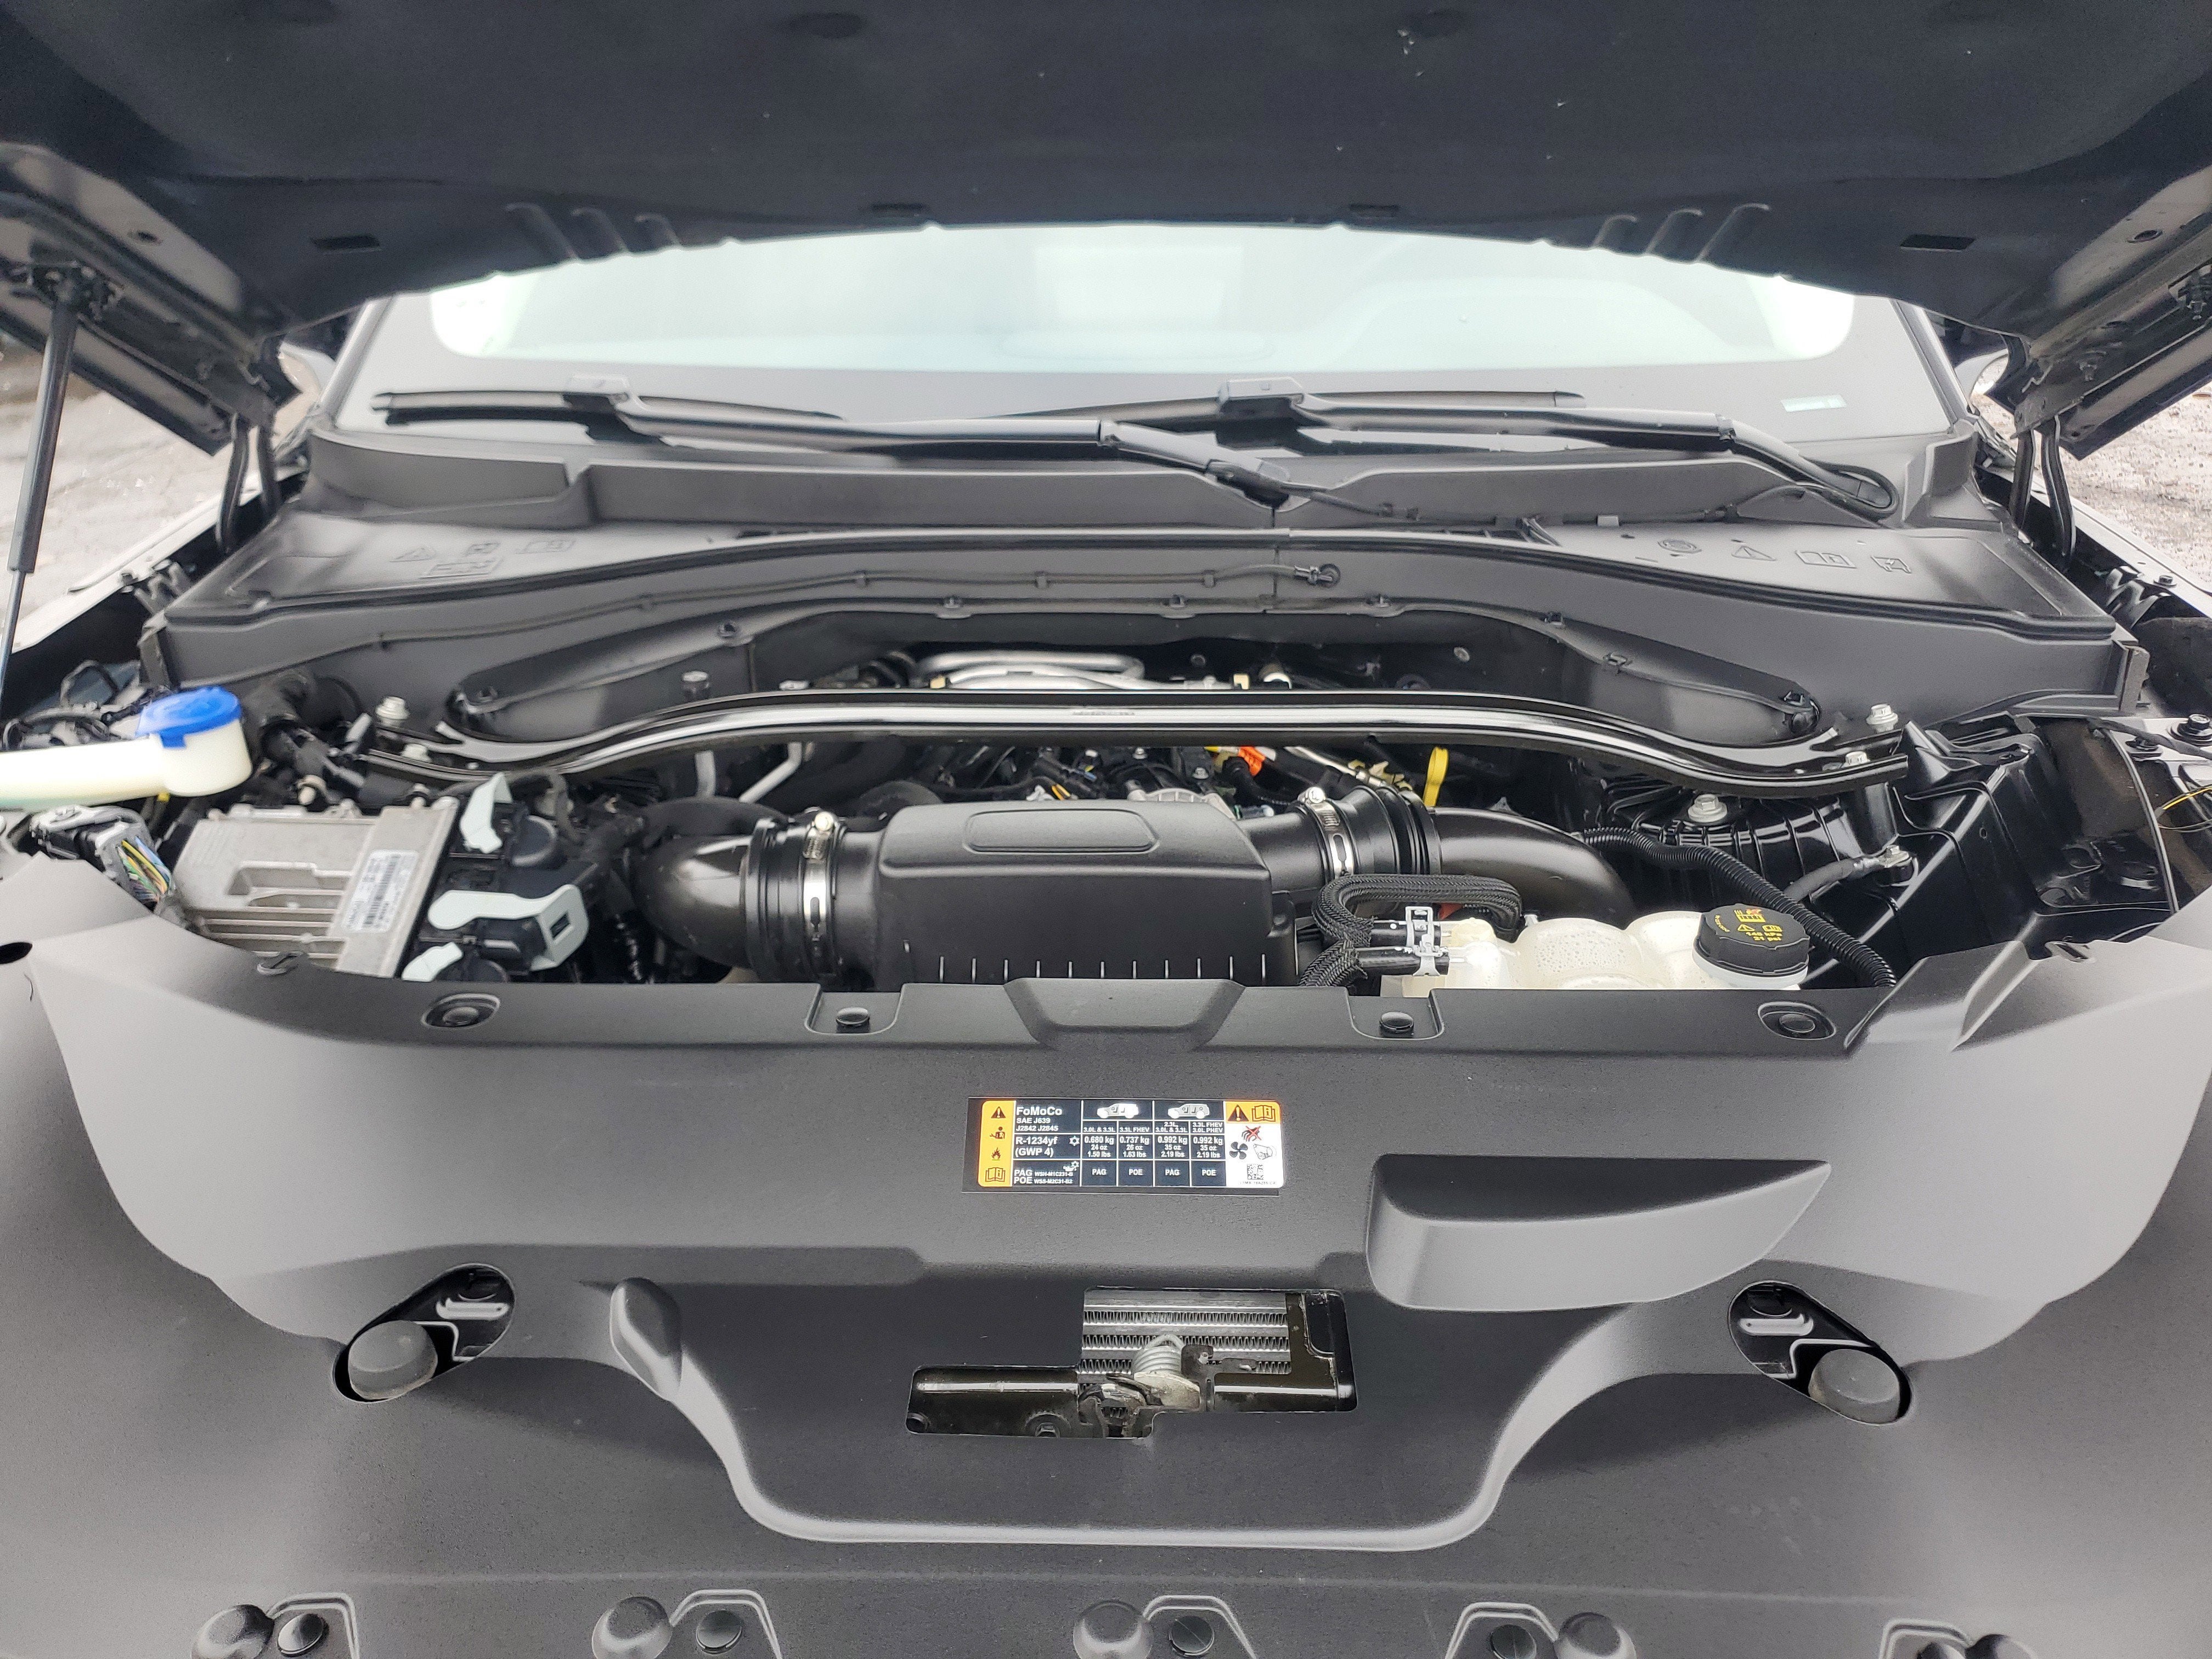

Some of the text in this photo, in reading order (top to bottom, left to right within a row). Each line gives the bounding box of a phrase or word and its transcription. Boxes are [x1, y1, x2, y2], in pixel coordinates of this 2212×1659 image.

[1016, 1106, 1063, 1115] FoMoCo
[1015, 1136, 1058, 1147] R-1234yf
[1105, 1136, 1114, 1145] kg
[1140, 1136, 1150, 1145] kg
[1178, 1136, 1188, 1145] kg
[1214, 1136, 1223, 1146] kg
[1015, 1147, 1054, 1158] (GWP 4)
